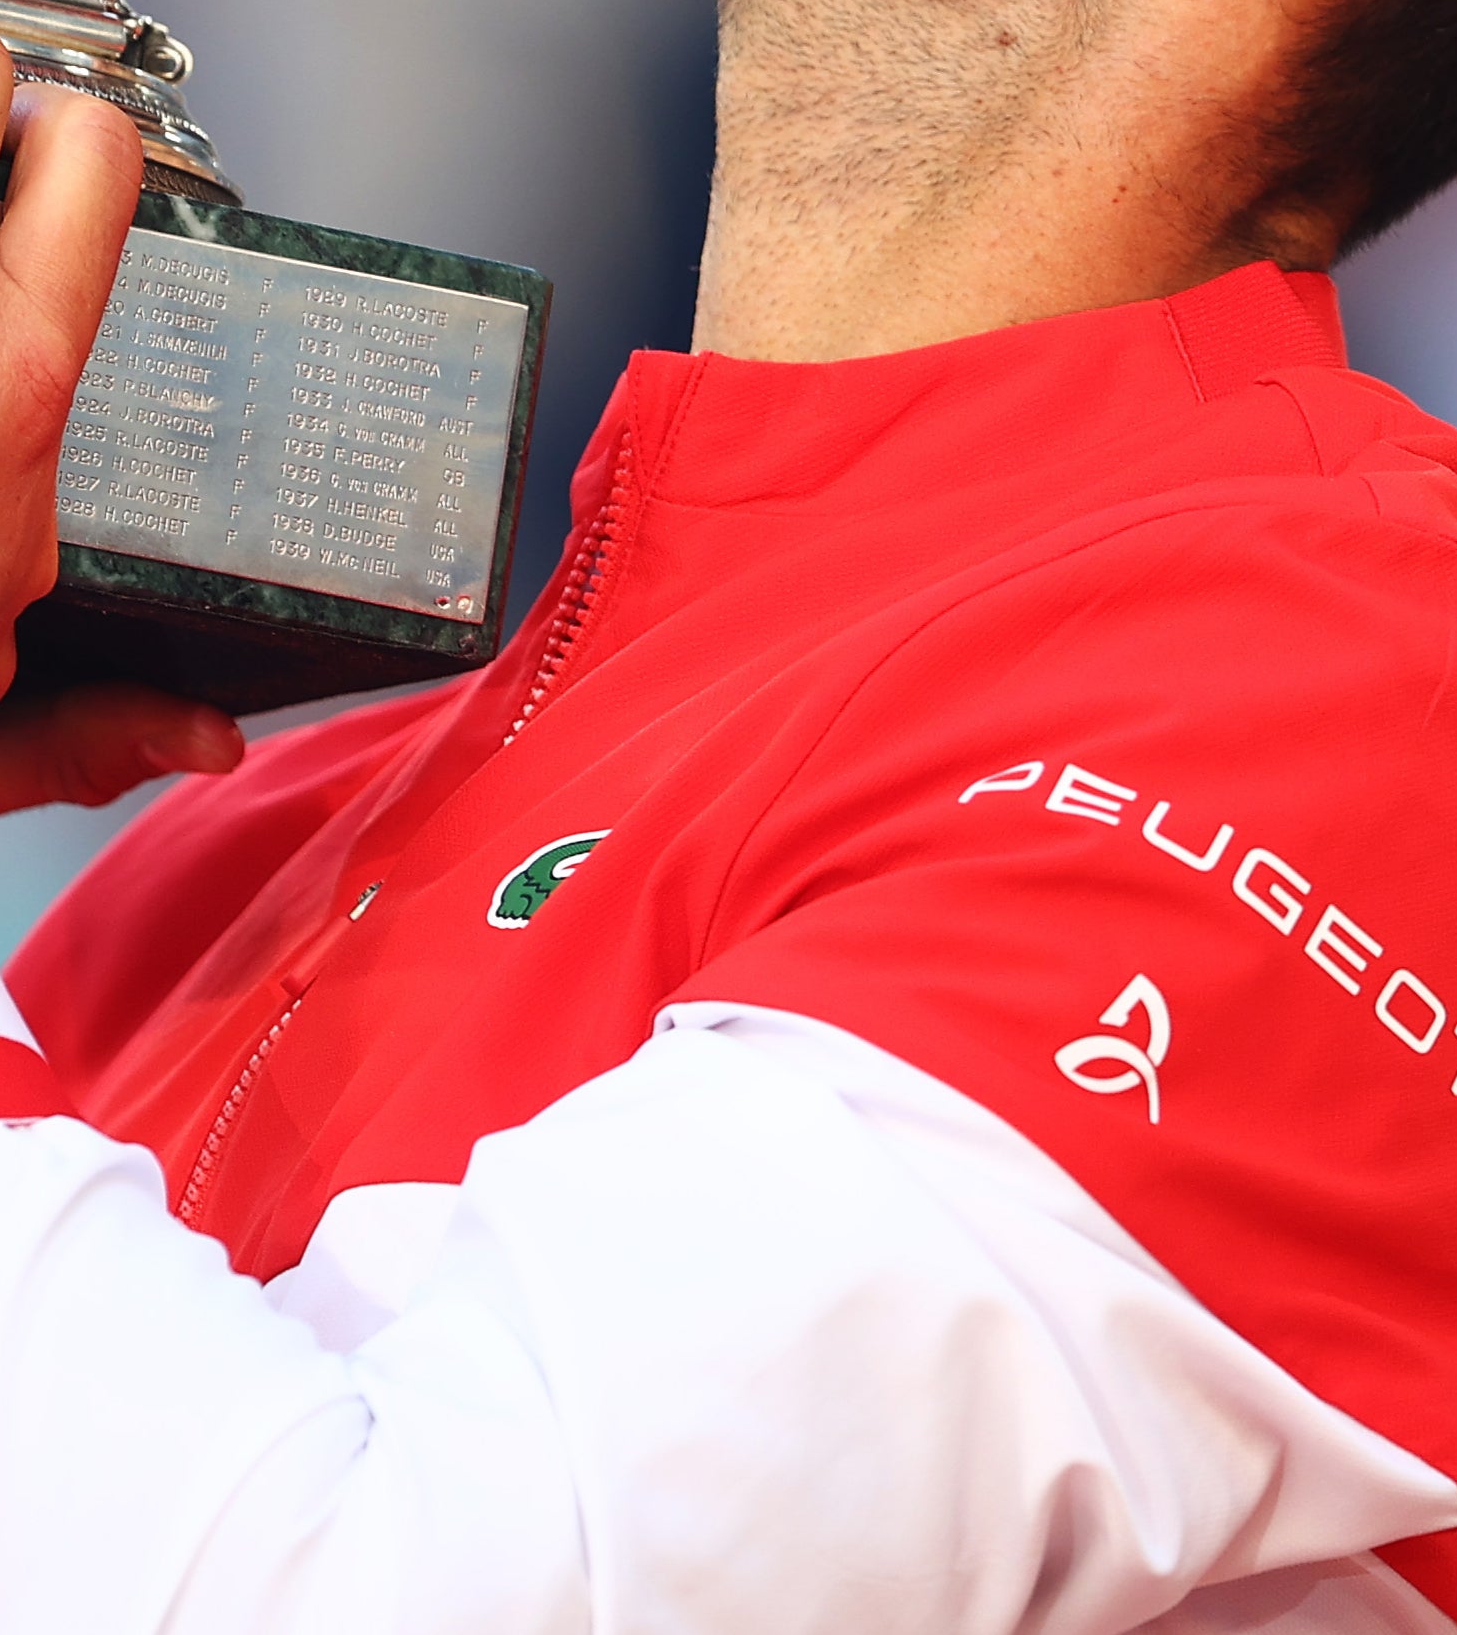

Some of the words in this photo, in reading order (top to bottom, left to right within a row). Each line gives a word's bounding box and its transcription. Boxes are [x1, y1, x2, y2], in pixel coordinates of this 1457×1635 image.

[262, 277, 274, 293] F
[259, 302, 271, 318] F
[305, 285, 347, 308] 1929
[477, 318, 489, 335] F
[251, 352, 264, 367] F
[255, 328, 267, 344] F
[302, 311, 344, 333] 1930
[473, 344, 485, 361] F
[298, 336, 340, 358] 1931
[469, 369, 482, 385] F
[80, 370, 115, 391] 923
[244, 402, 256, 418] F
[247, 377, 260, 393] F
[295, 362, 337, 385] 1932
[465, 395, 478, 411] F
[74, 396, 111, 416] 924
[240, 428, 253, 444] F
[287, 413, 330, 434] 1934
[380, 430, 426, 453] CRAMM
[291, 387, 333, 409] 1933
[358, 400, 426, 428] CRAWFORD
[439, 417, 474, 436] AUST
[62, 445, 103, 467] 1926
[233, 478, 245, 494] F
[237, 453, 249, 469] F
[280, 462, 322, 485] 1936
[283, 438, 326, 460] 1935
[443, 468, 465, 487] GB
[59, 470, 101, 492] 1927
[230, 503, 242, 520] F
[276, 487, 319, 509] 1937
[226, 529, 238, 545] F
[273, 512, 315, 536] 1938
[430, 544, 455, 563] USA
[269, 537, 311, 560] 1939
[426, 569, 451, 588] USA
